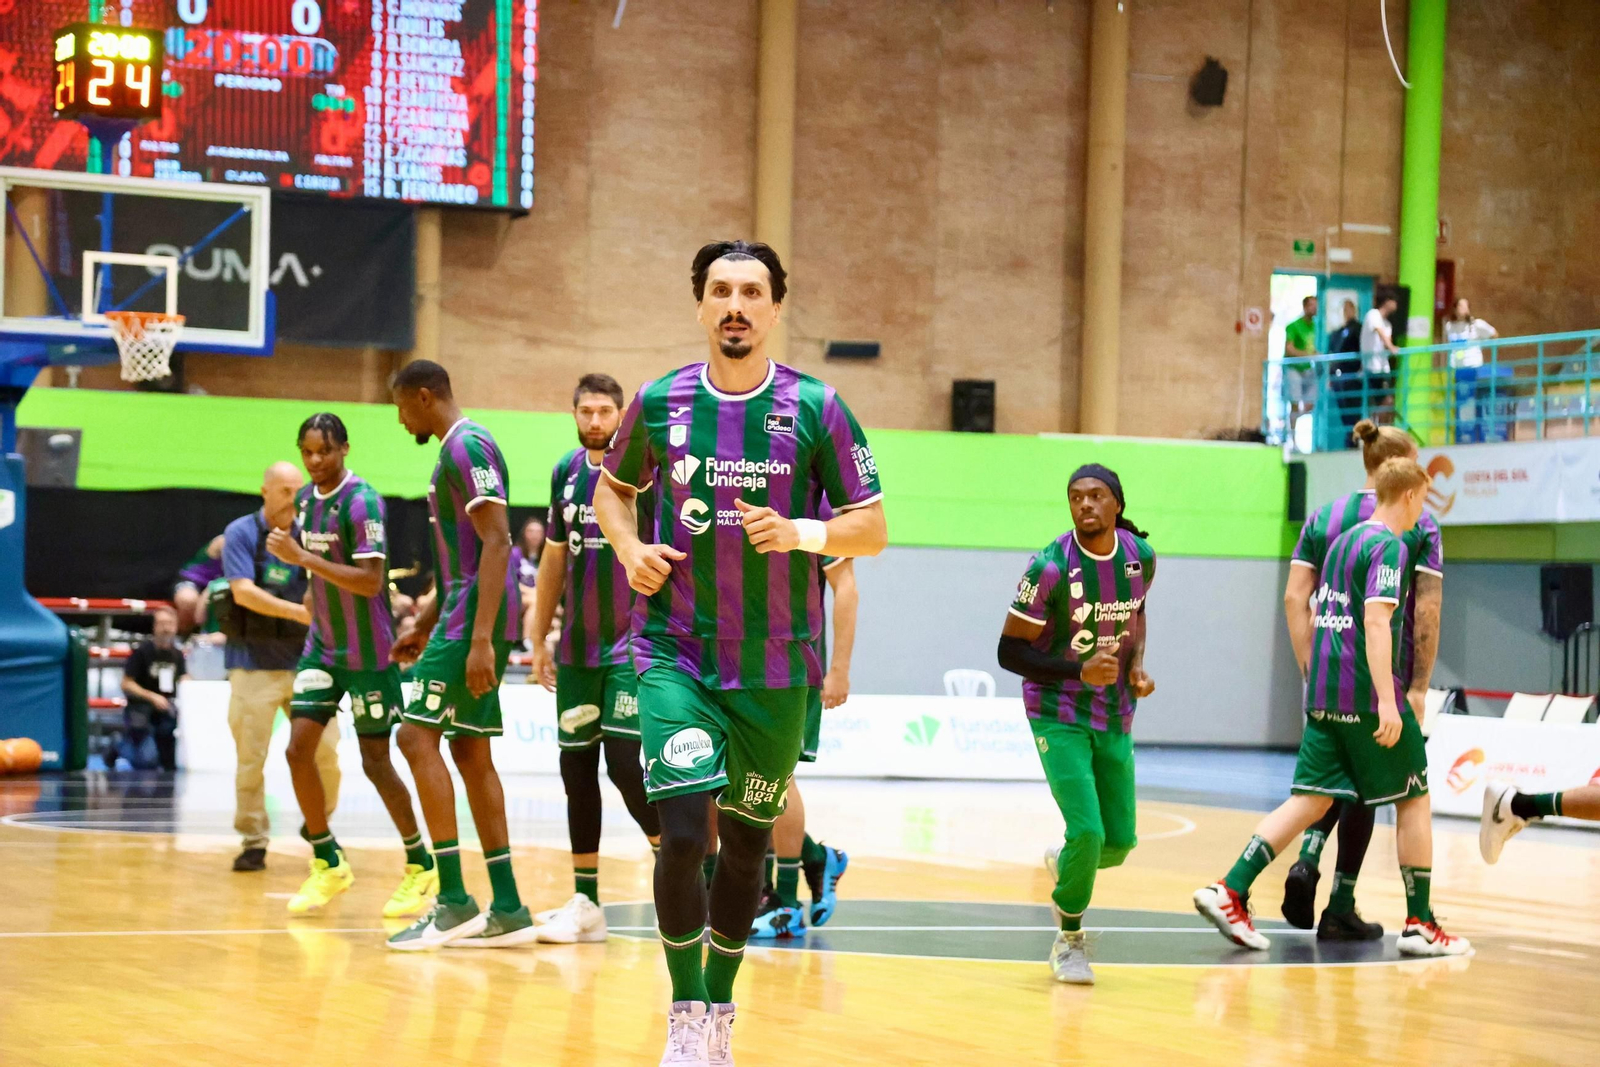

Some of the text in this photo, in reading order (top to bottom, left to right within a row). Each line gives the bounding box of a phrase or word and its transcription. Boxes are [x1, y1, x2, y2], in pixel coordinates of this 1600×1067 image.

[291, 0, 321, 35] 0
[184, 30, 314, 73] 20:00
[55, 62, 75, 110] 24
[88, 59, 152, 108] 24
[214, 73, 283, 93] PERIODO
[705, 457, 791, 475] Fundación
[705, 472, 767, 491] Unicaja
[716, 510, 744, 518] COSTA
[716, 517, 743, 526] MÁLA
[1094, 609, 1131, 623] Unicaja
[514, 719, 559, 743] Un
[668, 731, 712, 762] famadesa
[742, 785, 774, 806] laga
[749, 778, 780, 793] má
